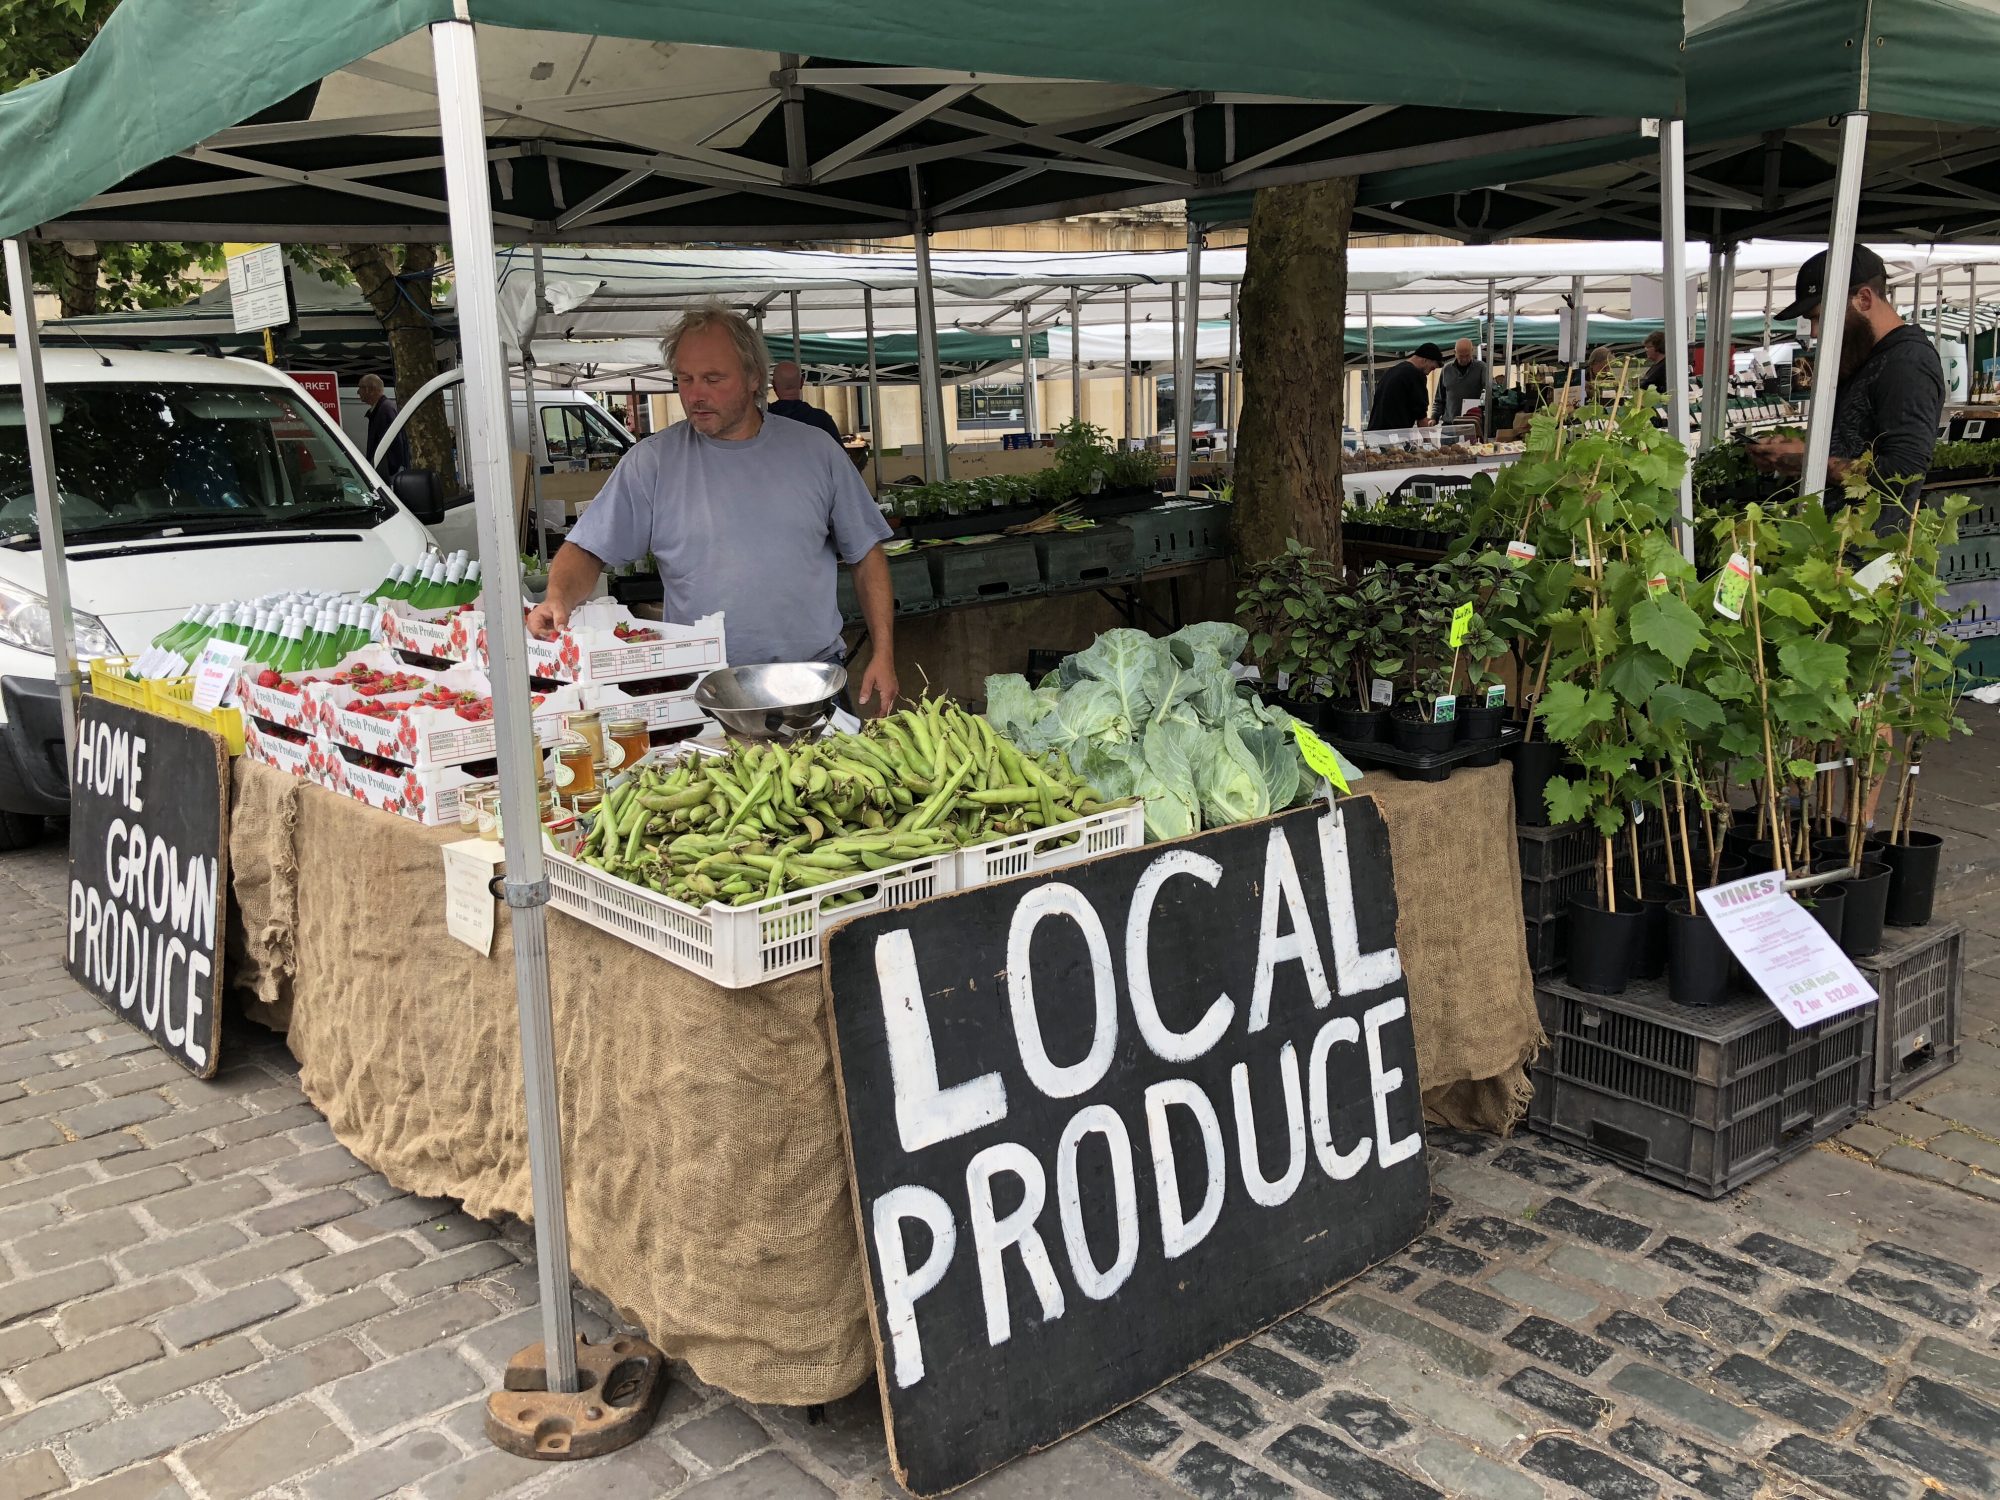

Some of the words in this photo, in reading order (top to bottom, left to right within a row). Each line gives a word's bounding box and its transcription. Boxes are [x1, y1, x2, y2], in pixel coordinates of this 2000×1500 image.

[402, 622, 419, 635] Fresh
[419, 625, 444, 640] Produce
[527, 643, 552, 659] roduce
[256, 689, 272, 703] Fresh
[272, 694, 296, 710] Produce
[342, 713, 362, 729] Fresh
[362, 719, 391, 737] Produce
[262, 737, 279, 752] Fresh
[278, 743, 303, 760] Produce
[77, 718, 146, 812] HOME
[348, 768, 368, 784] Fresh
[368, 775, 397, 793] Produce
[106, 818, 217, 950] GROWN
[1713, 878, 1775, 908] VINES
[69, 879, 211, 1066] PRODUCE
[873, 807, 1402, 1153] LOCAL
[1793, 999, 1807, 1014] 2
[1807, 998, 1823, 1010] for
[1824, 982, 1860, 1003] £12.00
[872, 997, 1422, 1389] PRODUCE
